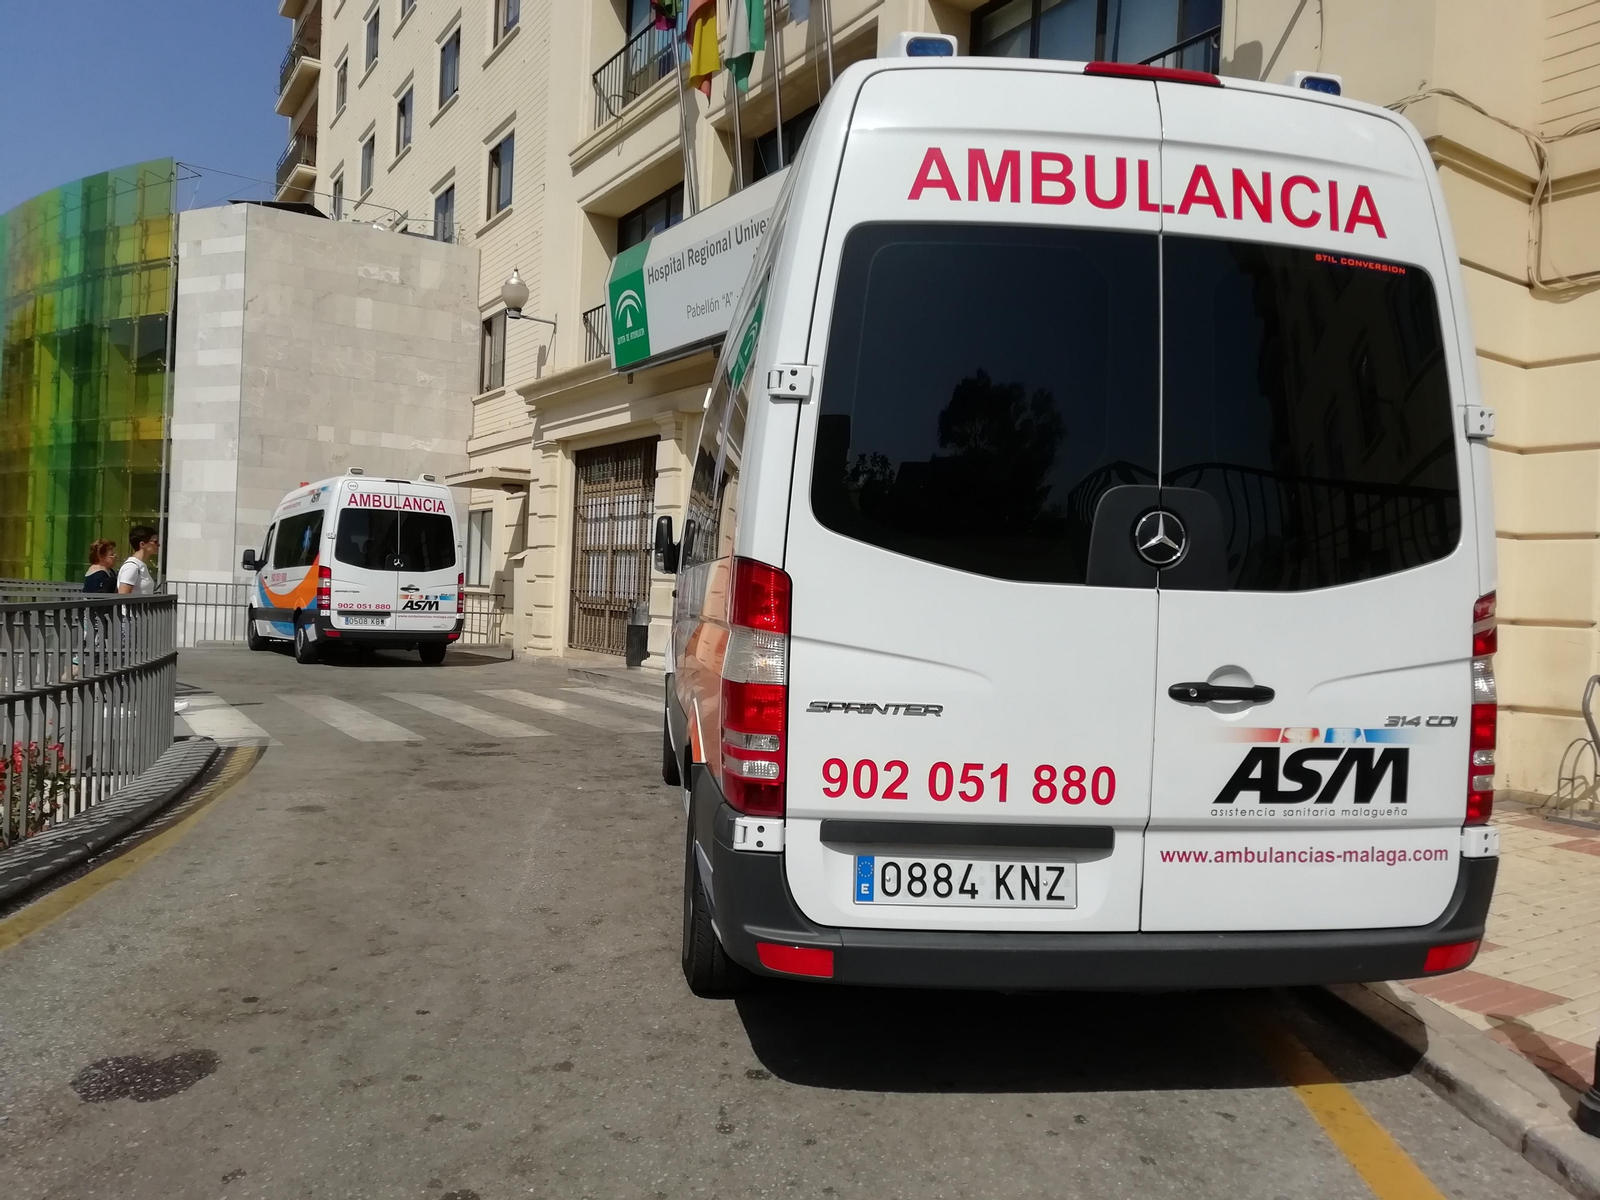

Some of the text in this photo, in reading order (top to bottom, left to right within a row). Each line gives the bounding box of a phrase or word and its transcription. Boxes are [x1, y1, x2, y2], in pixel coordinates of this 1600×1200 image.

[907, 147, 1388, 239] AMBULANCIA
[647, 217, 770, 285] Hospital Regional Unive
[1315, 253, 1406, 275] STIL CONVERSION
[686, 298, 720, 320] Pabellón
[347, 493, 446, 513] AMBULANCIA
[401, 600, 439, 611] ASM
[806, 701, 944, 718] SPRINTER
[1384, 715, 1458, 727] 314 CDI
[821, 757, 1117, 806] 902 051 880
[1212, 746, 1410, 804] ASM
[1210, 805, 1408, 819] asistencia sanitaria malagueña
[1160, 846, 1450, 867] www.ambulancias-malaga.com
[860, 882, 870, 895] E
[880, 861, 1066, 901] 0884 KNZ
